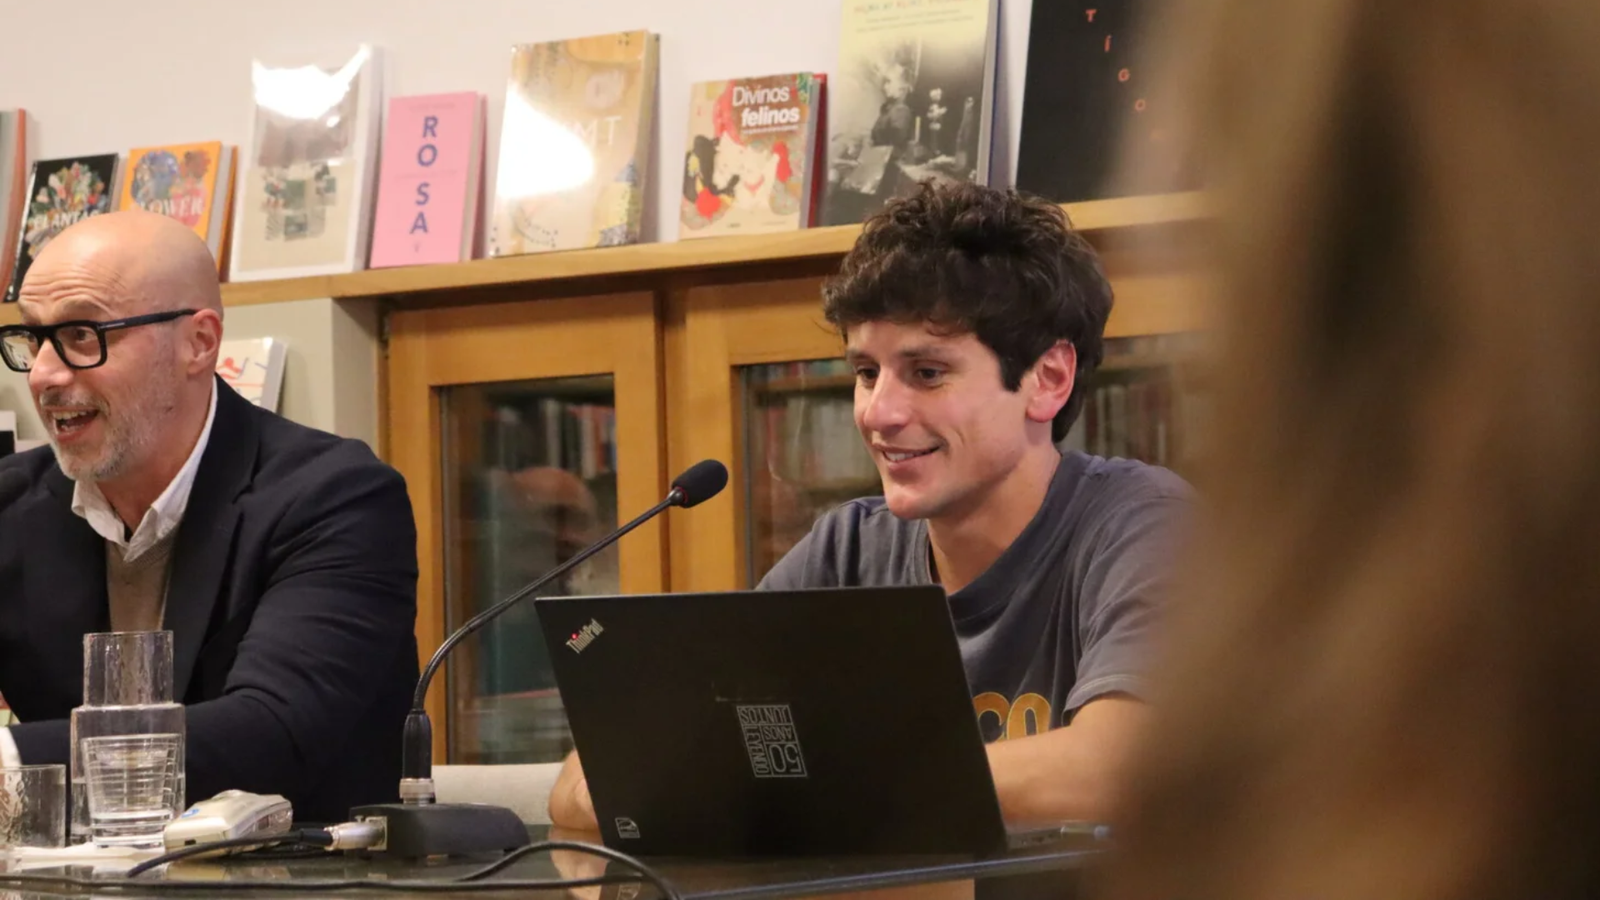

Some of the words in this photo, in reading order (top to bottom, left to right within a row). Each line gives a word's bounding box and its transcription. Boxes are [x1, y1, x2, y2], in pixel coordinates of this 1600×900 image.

[732, 85, 790, 107] Divinos
[741, 105, 800, 127] felinos
[409, 115, 439, 235] ROSA
[565, 617, 604, 654] ThinkPad
[740, 706, 788, 724] JUNTOS
[769, 744, 802, 773] 50
